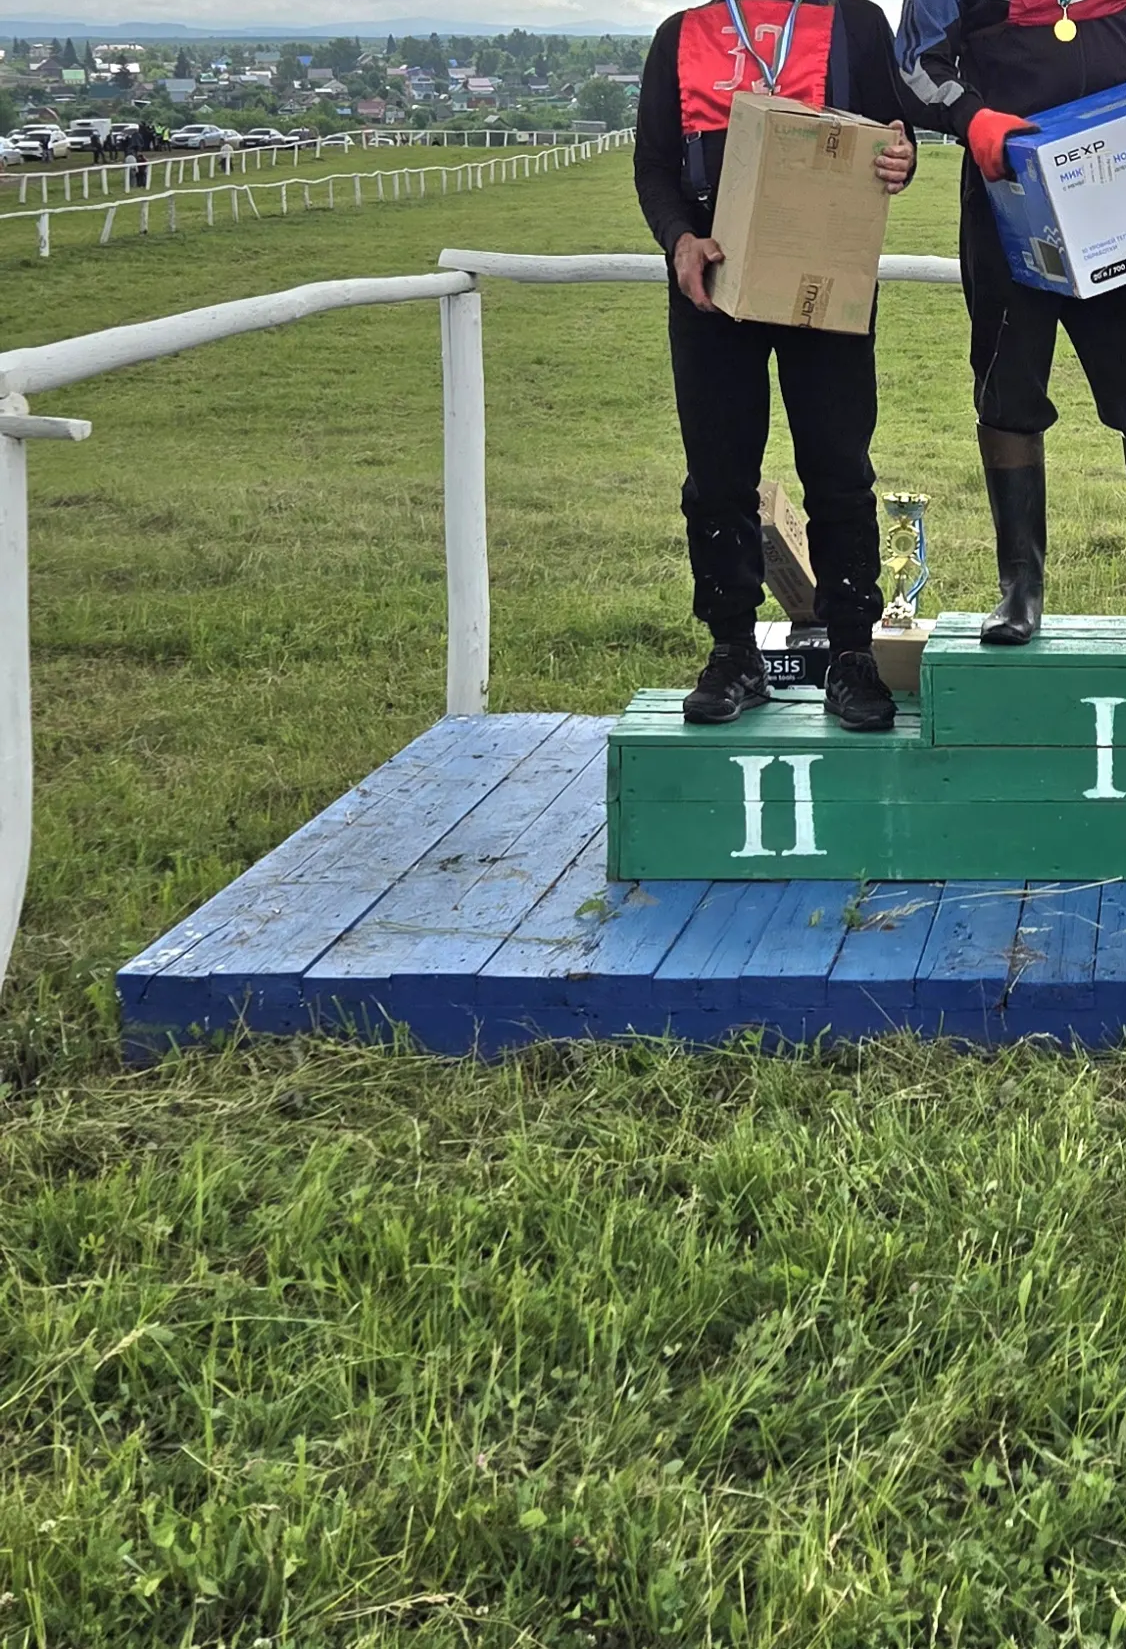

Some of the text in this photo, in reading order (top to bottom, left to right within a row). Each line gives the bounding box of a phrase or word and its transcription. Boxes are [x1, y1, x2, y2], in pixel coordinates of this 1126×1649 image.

[1054, 140, 1105, 167] DEXP
[1113, 263, 1126, 274] 700
[764, 655, 800, 673] asis
[729, 754, 828, 857] II
